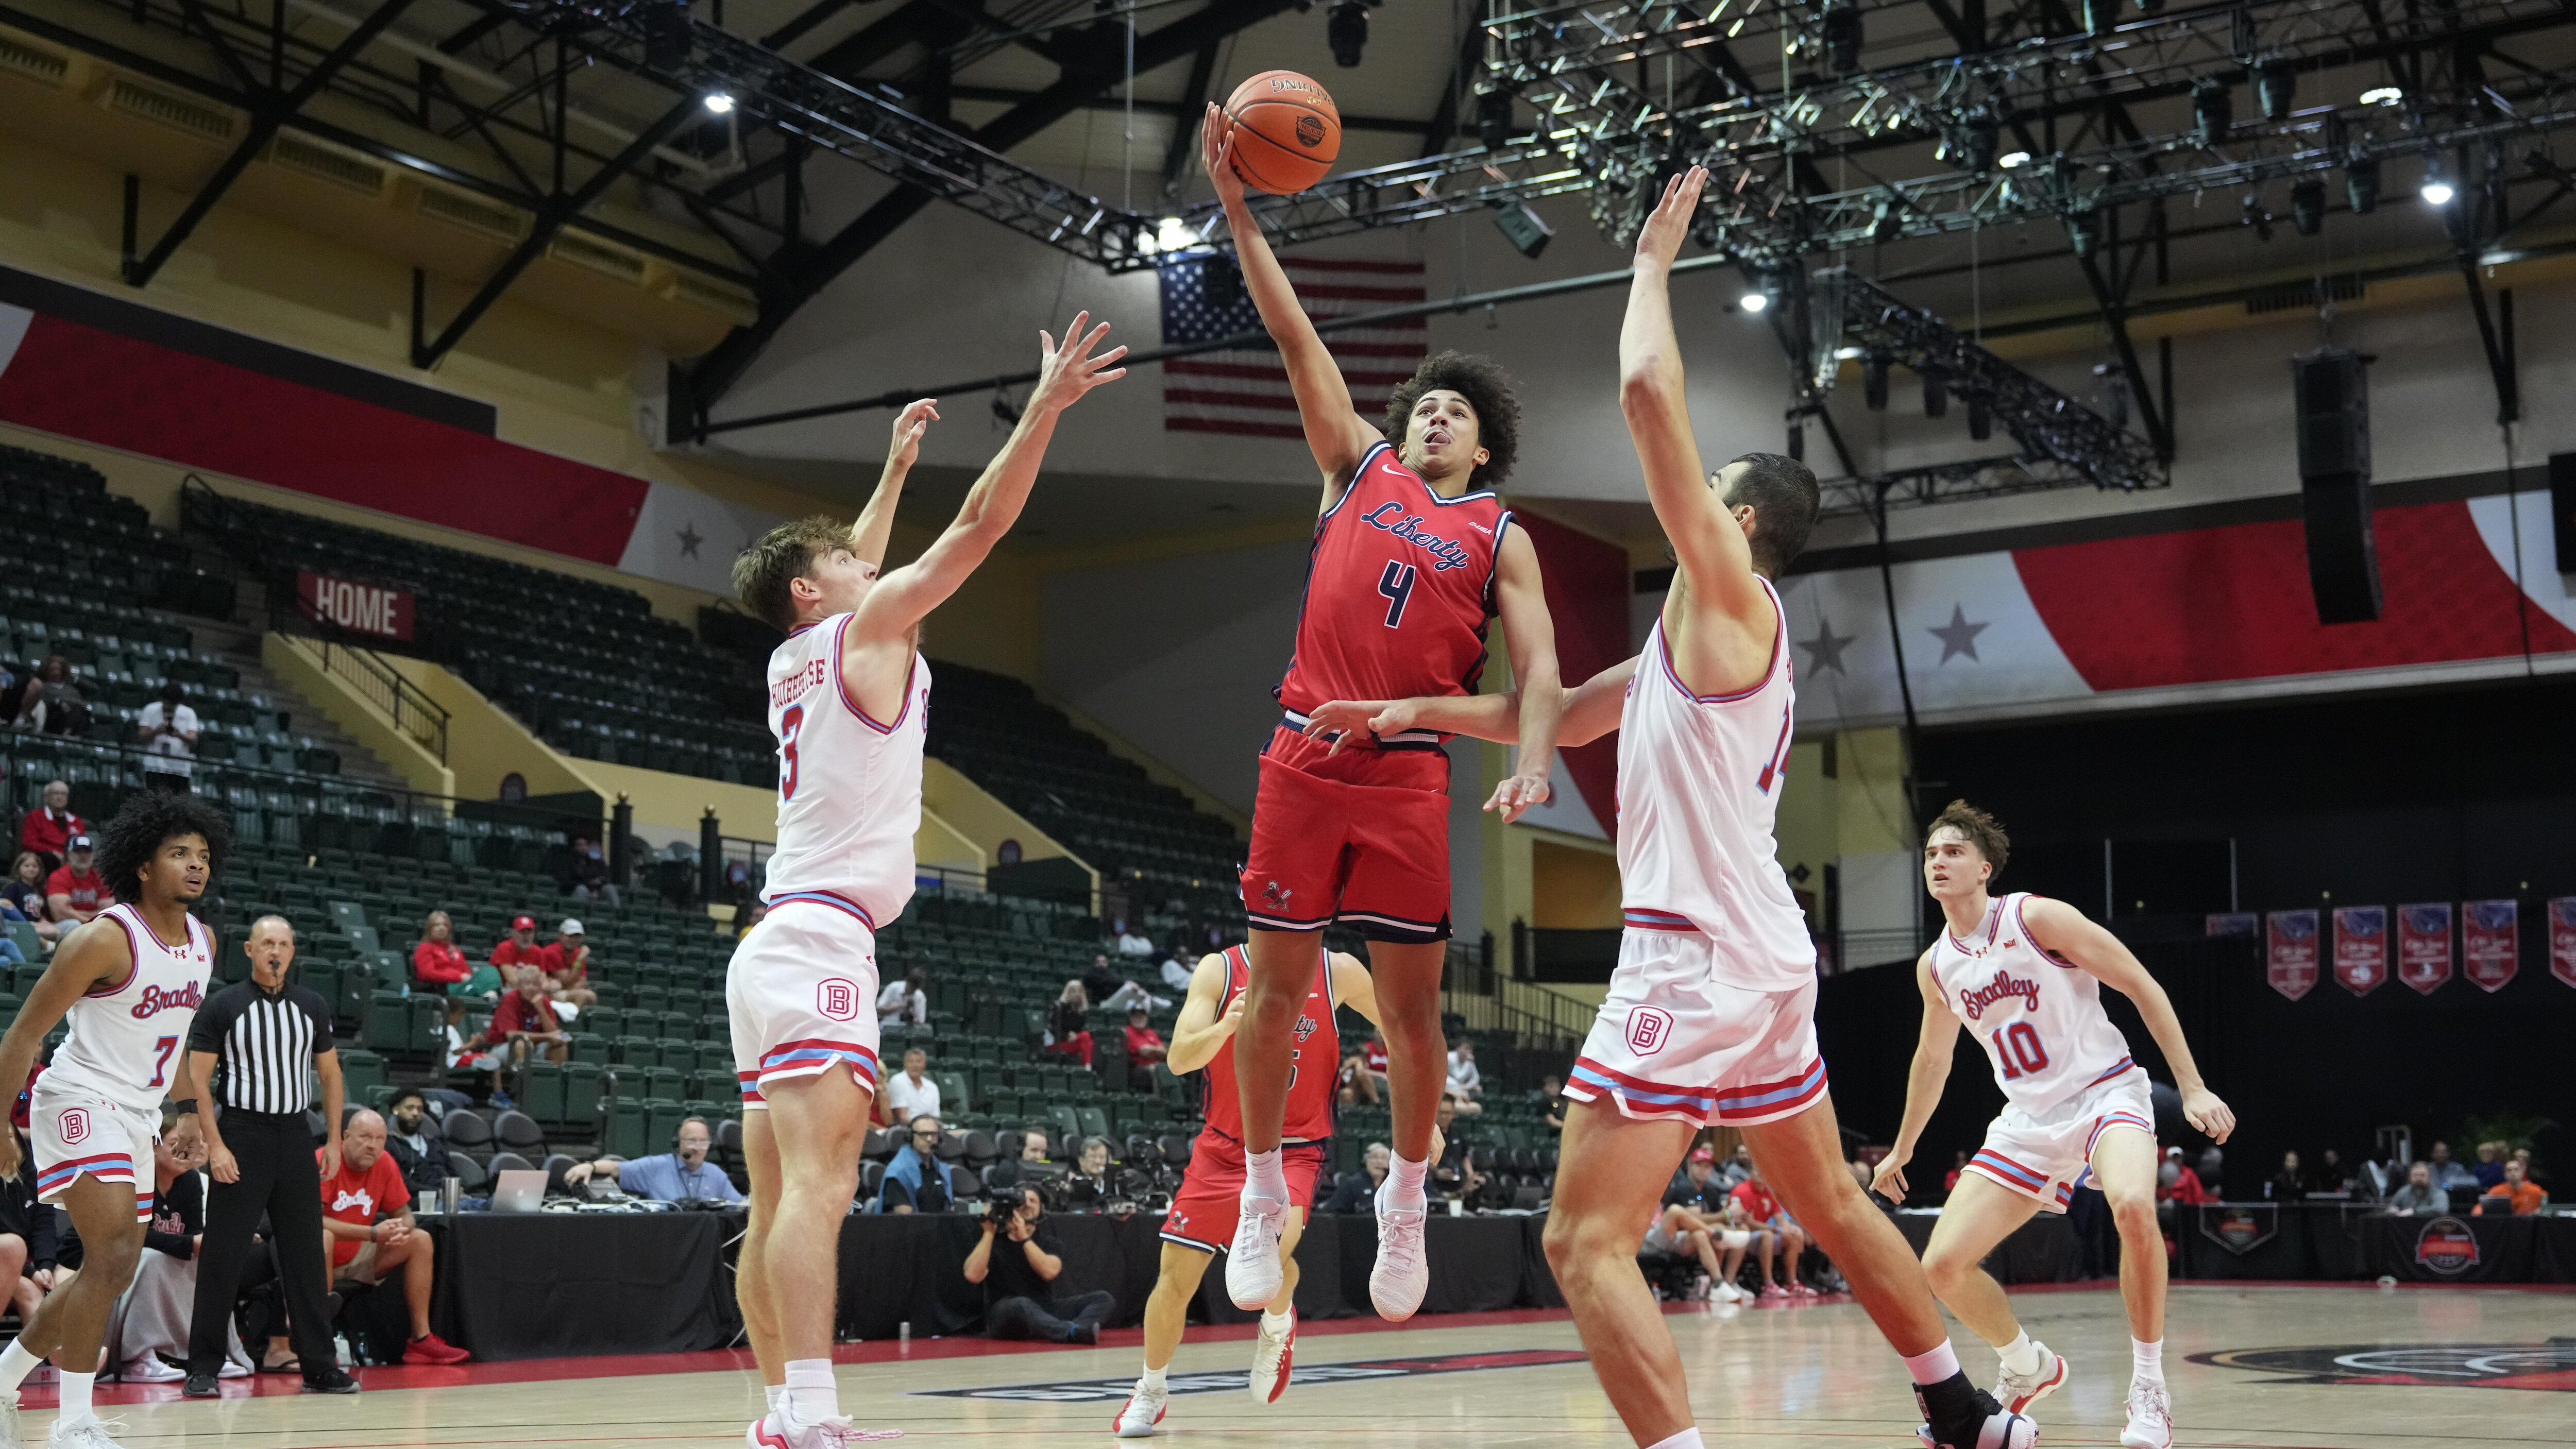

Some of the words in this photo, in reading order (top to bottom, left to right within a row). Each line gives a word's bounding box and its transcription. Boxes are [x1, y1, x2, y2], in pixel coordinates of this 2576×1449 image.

[1360, 501, 1469, 572] Liberty
[316, 577, 398, 636] HOME
[1378, 558, 1416, 628] 4
[781, 703, 805, 804] 3
[131, 980, 205, 1019] Bradle
[826, 985, 850, 1014] B
[1960, 970, 2040, 1020] Bradley
[1632, 1012, 1662, 1048] B
[1991, 1021, 2049, 1082] 10
[147, 1035, 179, 1087] 7
[64, 1114, 83, 1139] B
